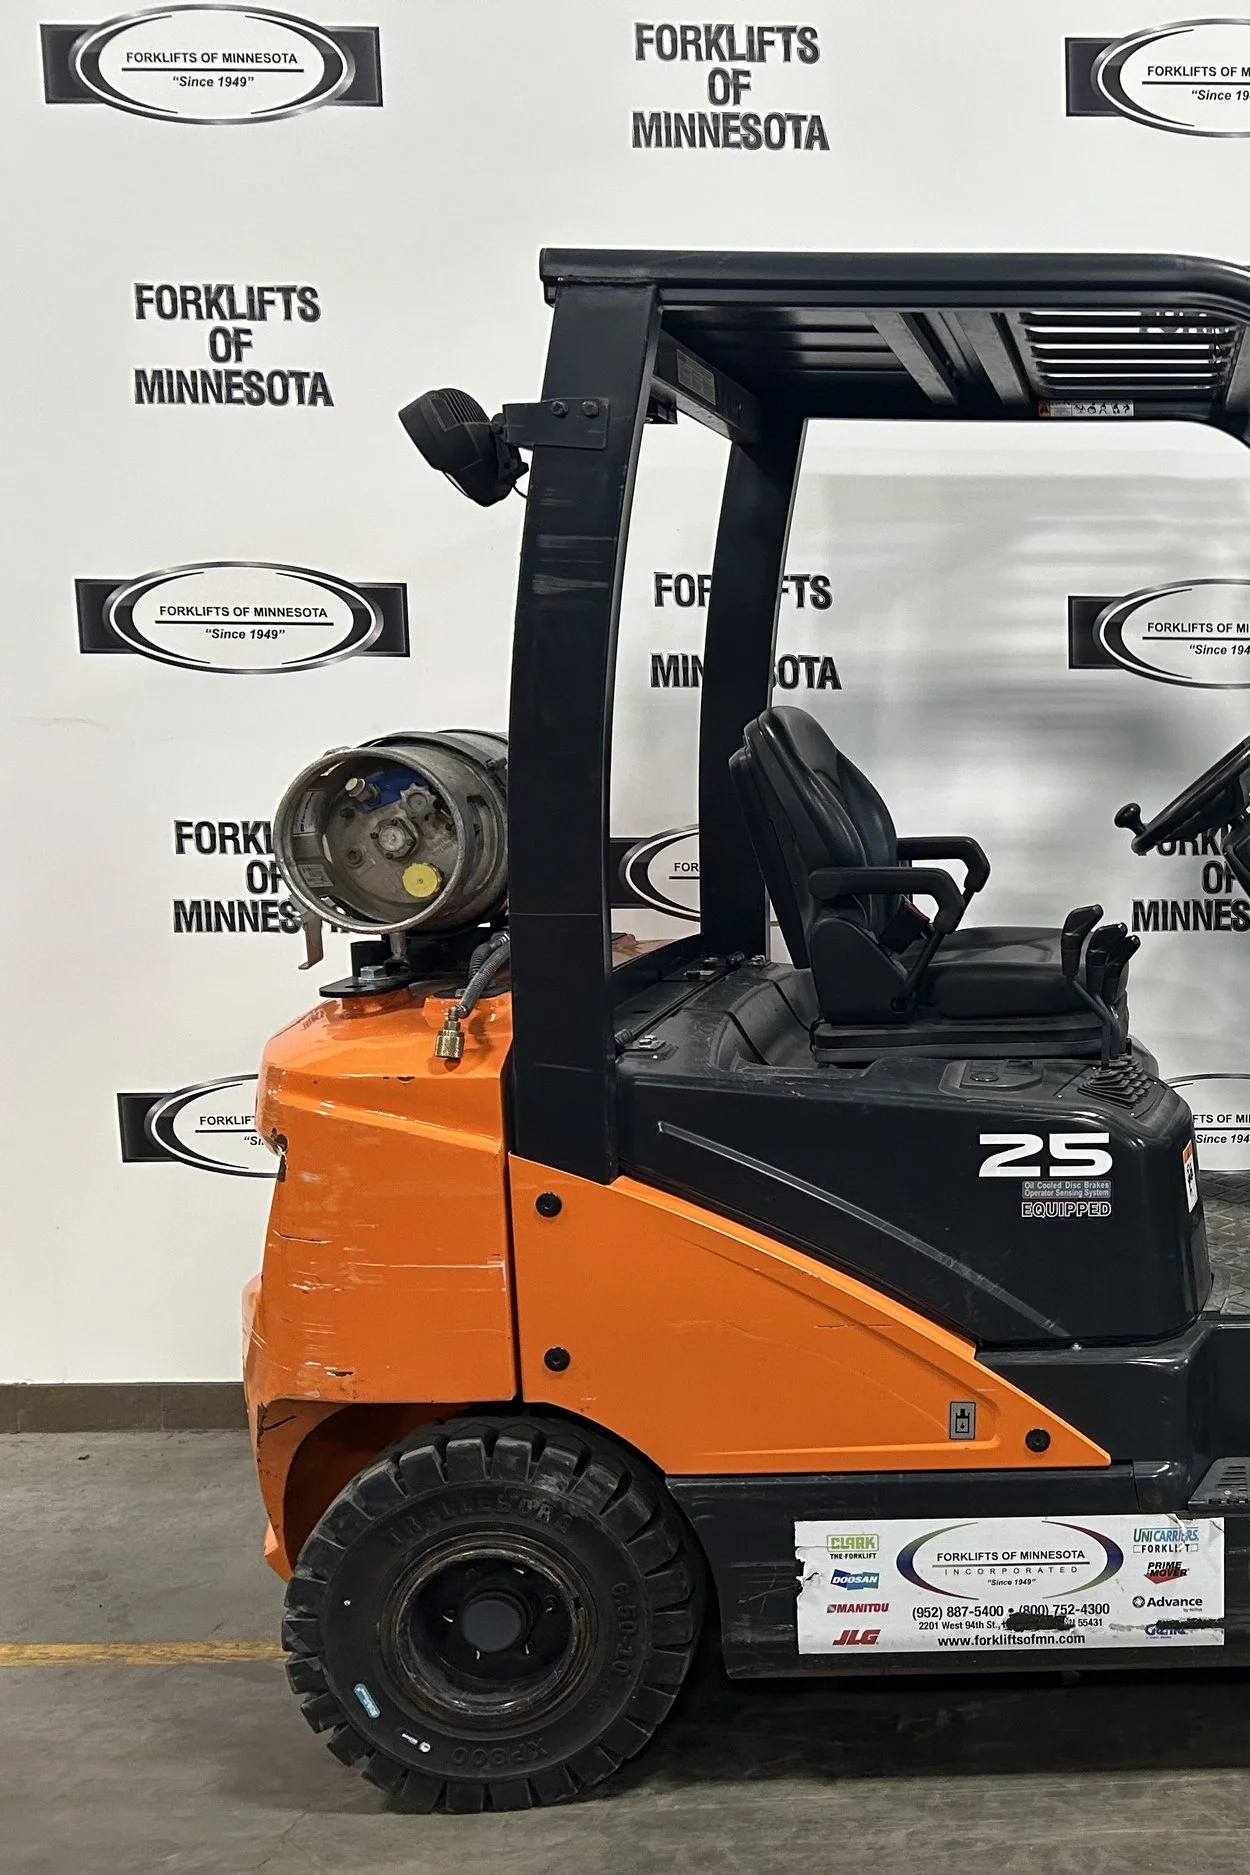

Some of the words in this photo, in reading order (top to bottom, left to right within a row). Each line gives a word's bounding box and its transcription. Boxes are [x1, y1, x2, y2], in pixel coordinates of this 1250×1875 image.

[635, 23, 820, 64] FORKLIFTS
[126, 51, 198, 64] FORKLIFTS
[200, 52, 218, 64] OF
[221, 52, 298, 64] MINNESOTA
[1147, 65, 1217, 77] FORKLIFTS
[1220, 66, 1238, 77] OF
[708, 67, 751, 106] OF
[633, 111, 830, 150] MINNESOTA
[134, 283, 320, 322] FORKLIFTS
[210, 326, 253, 363] OF
[135, 368, 334, 406] MINNESOTA
[159, 605, 230, 617] FORKLIFTS
[232, 606, 250, 617] OF
[253, 606, 328, 618] MINNESOTA
[1147, 622, 1214, 634] FORKLIFTS
[1216, 623, 1233, 634] OF
[173, 898, 302, 934] MINNES
[1216, 1114, 1232, 1124] OF
[978, 1132, 1113, 1178] 25
[1024, 1181, 1035, 1189] Oil
[1037, 1181, 1062, 1189] Cooled
[1065, 1181, 1081, 1189] Disc
[1084, 1181, 1110, 1189] Brakes
[1024, 1189, 1054, 1198] Operator
[1055, 1189, 1083, 1198] Sensing
[1084, 1189, 1109, 1198] System
[1021, 1201, 1112, 1219] EQUIPPED
[830, 1537, 875, 1550] CLARK
[1141, 1543, 1190, 1553] FORKLIT
[936, 1551, 999, 1562] FORKLIFTS
[1001, 1551, 1018, 1561] OF
[1020, 1550, 1086, 1560] MINNESOTA
[944, 1566, 1078, 1576] INCORPORATED
[1148, 1561, 1182, 1570] PRIME
[1149, 1568, 1188, 1577] MOVER
[832, 1575, 879, 1584] DOOSAN
[836, 1602, 890, 1614] MANITOU
[1146, 1596, 1203, 1608] Advance
[912, 1606, 943, 1620] (952)
[946, 1605, 1005, 1618] 887-5400
[1052, 1603, 1110, 1616] 752-4300
[918, 1621, 939, 1631] 2201
[941, 1620, 963, 1630] West
[965, 1620, 985, 1630] 94th
[1077, 1617, 1103, 1627] 55431
[937, 1633, 1086, 1647] www.forkliftsofmn.com
